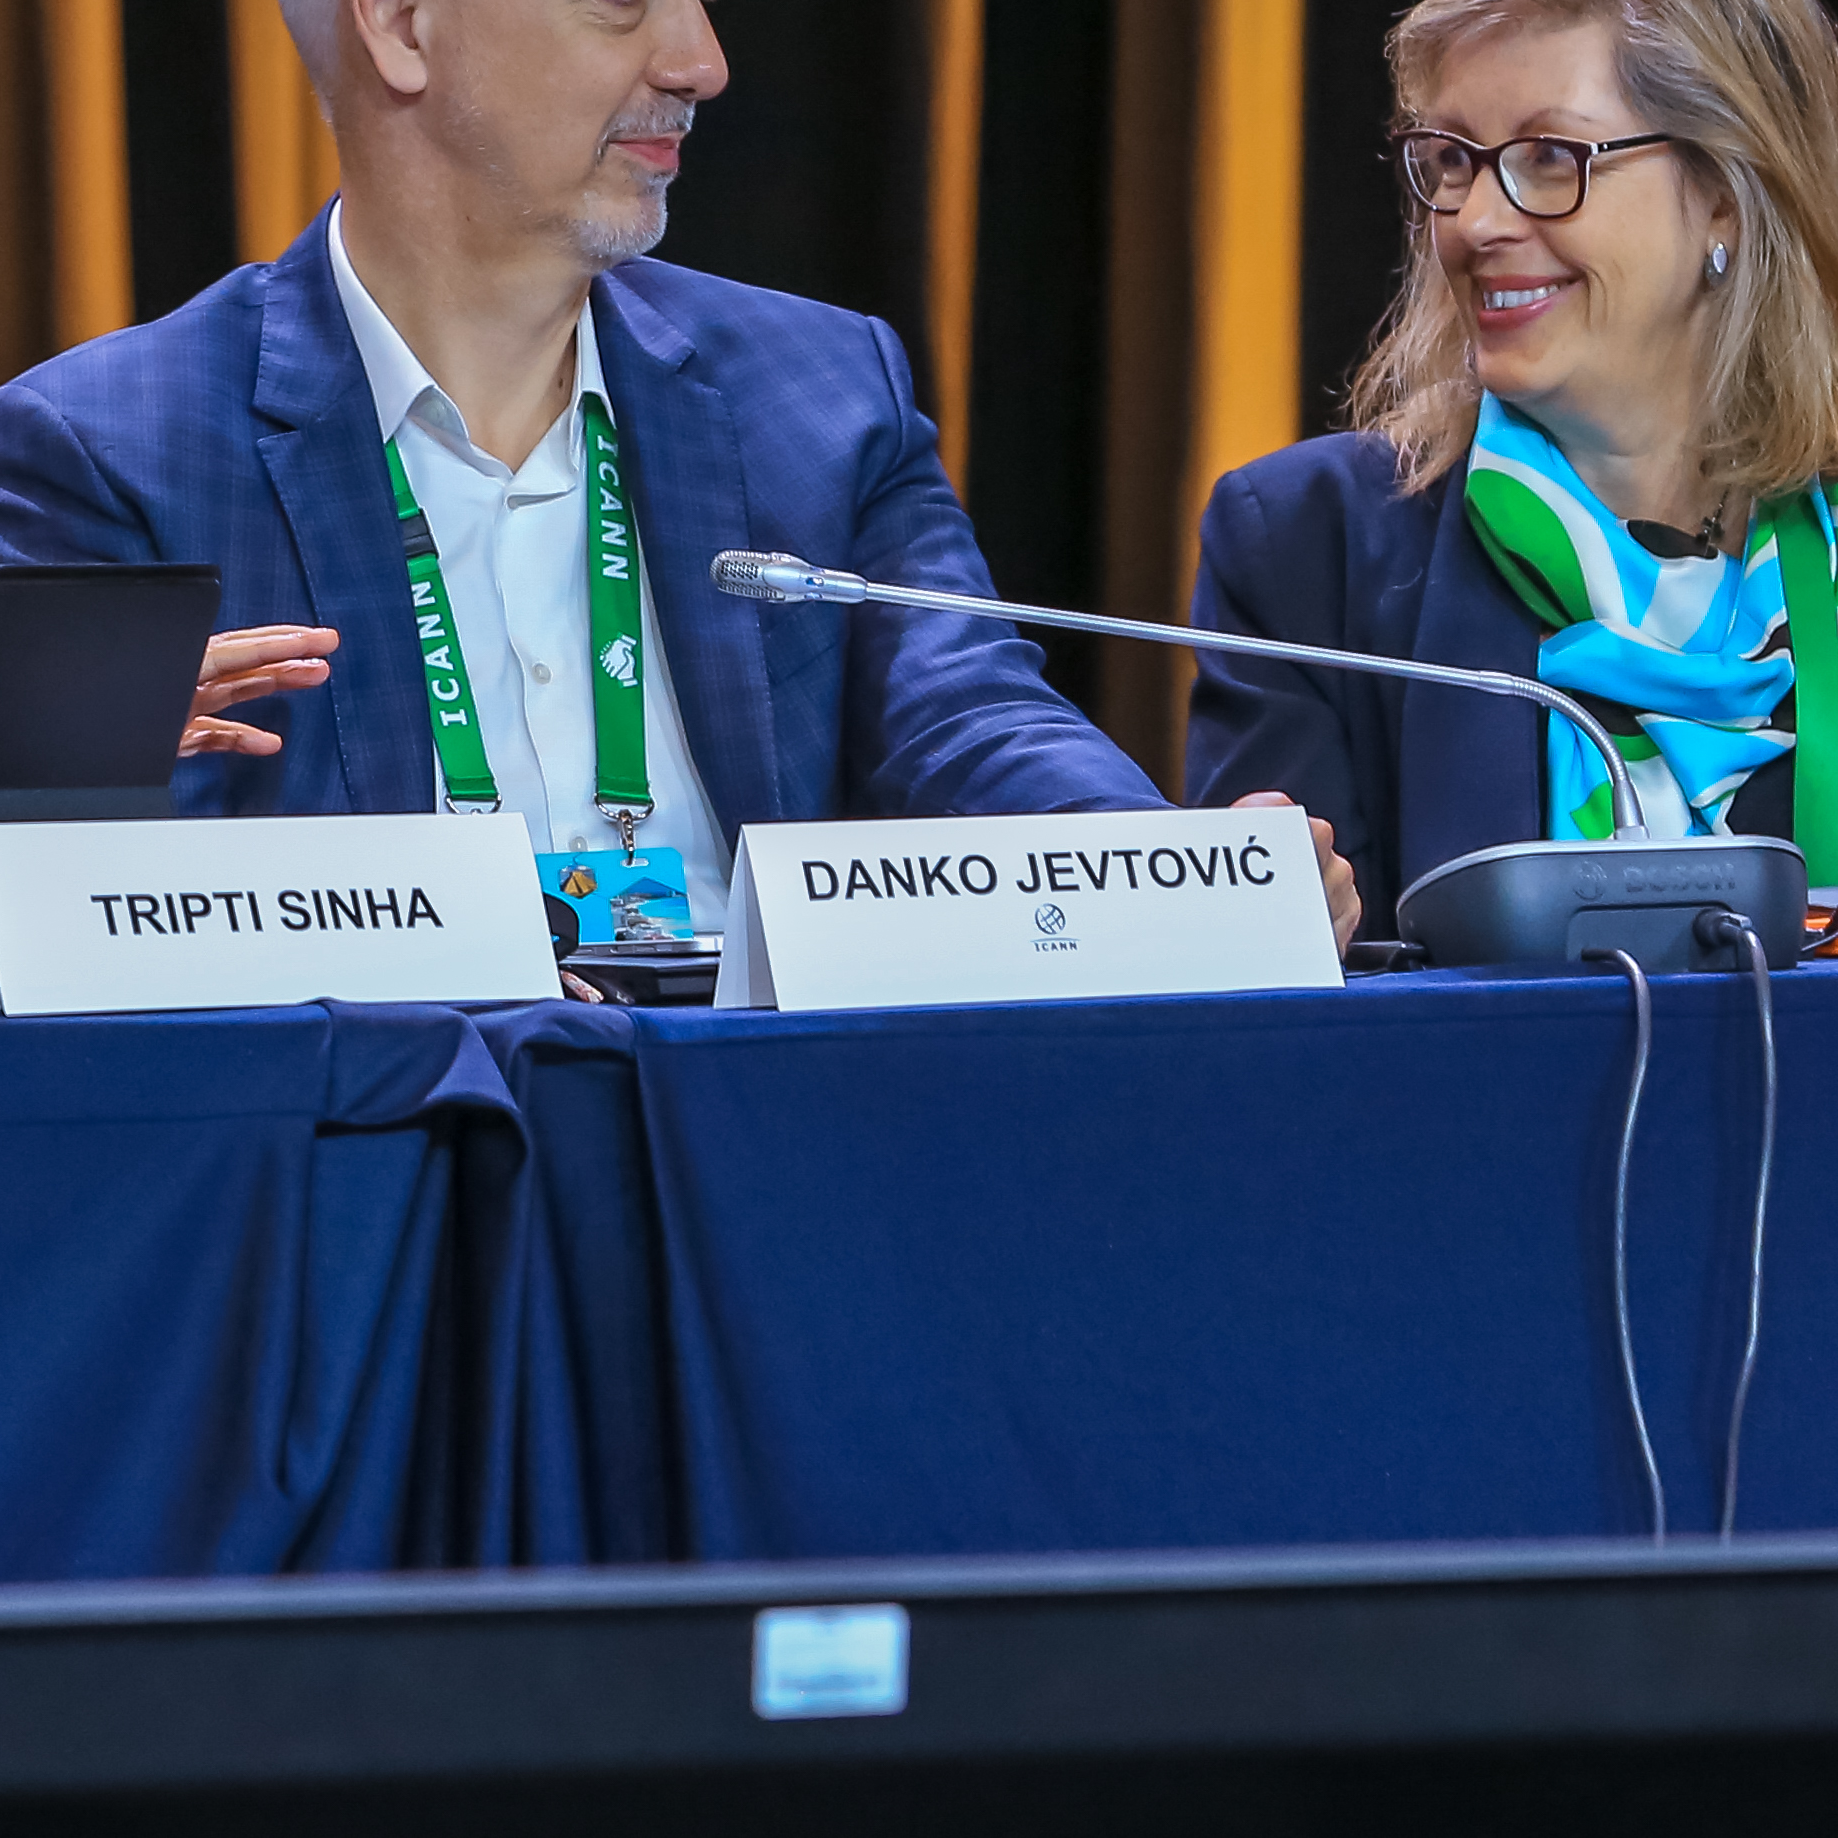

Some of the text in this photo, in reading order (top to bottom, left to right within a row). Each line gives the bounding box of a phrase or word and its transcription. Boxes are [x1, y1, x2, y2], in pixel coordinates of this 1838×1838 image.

[596, 434, 630, 581] ICANN
[411, 579, 468, 728] ICANN
[801, 835, 1275, 903] DANKO JEVTOVIĆ
[90, 886, 444, 936] TRIPTI SINHA
[1034, 942, 1078, 952] ICANN
